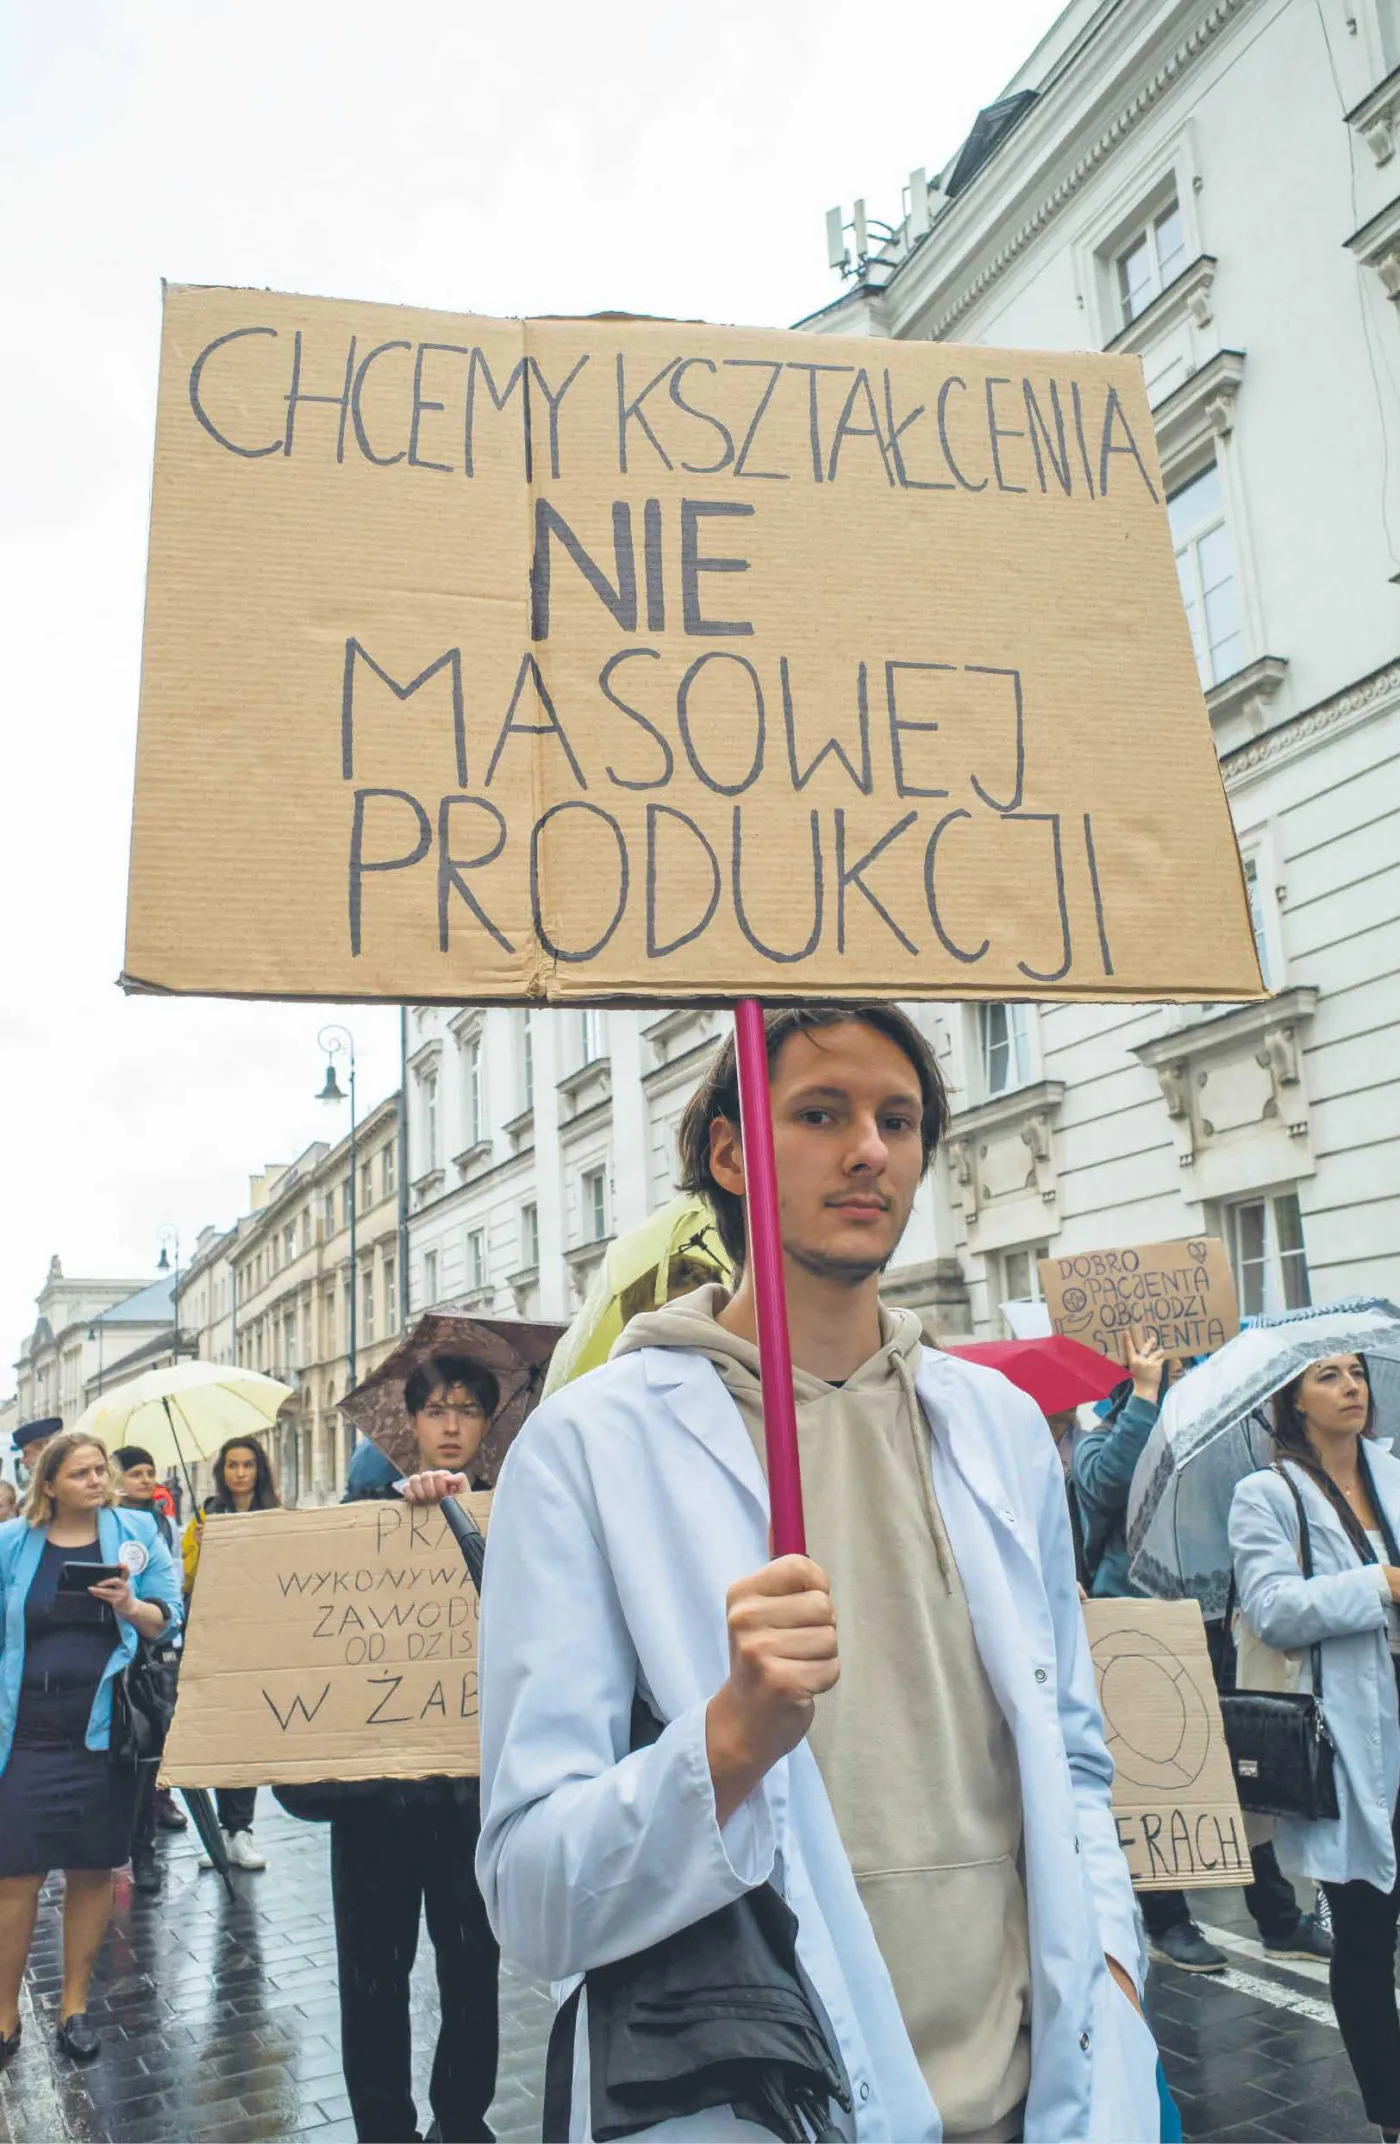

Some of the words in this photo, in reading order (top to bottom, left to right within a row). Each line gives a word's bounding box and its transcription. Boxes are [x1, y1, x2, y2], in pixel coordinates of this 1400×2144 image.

[189, 326, 590, 484] CHCEMY
[616, 351, 1160, 504] KSZTAŁCENIA
[530, 497, 756, 641] NIE
[341, 636, 1024, 811] MASOWEJ
[350, 787, 1114, 982] PRODUKCJI
[1057, 1250, 1139, 1280] DOBRO
[1084, 1266, 1210, 1304] PACJENTA
[1099, 1295, 1208, 1328] OBCHODZI
[345, 1632, 386, 1666] OD
[261, 1681, 331, 1731] W
